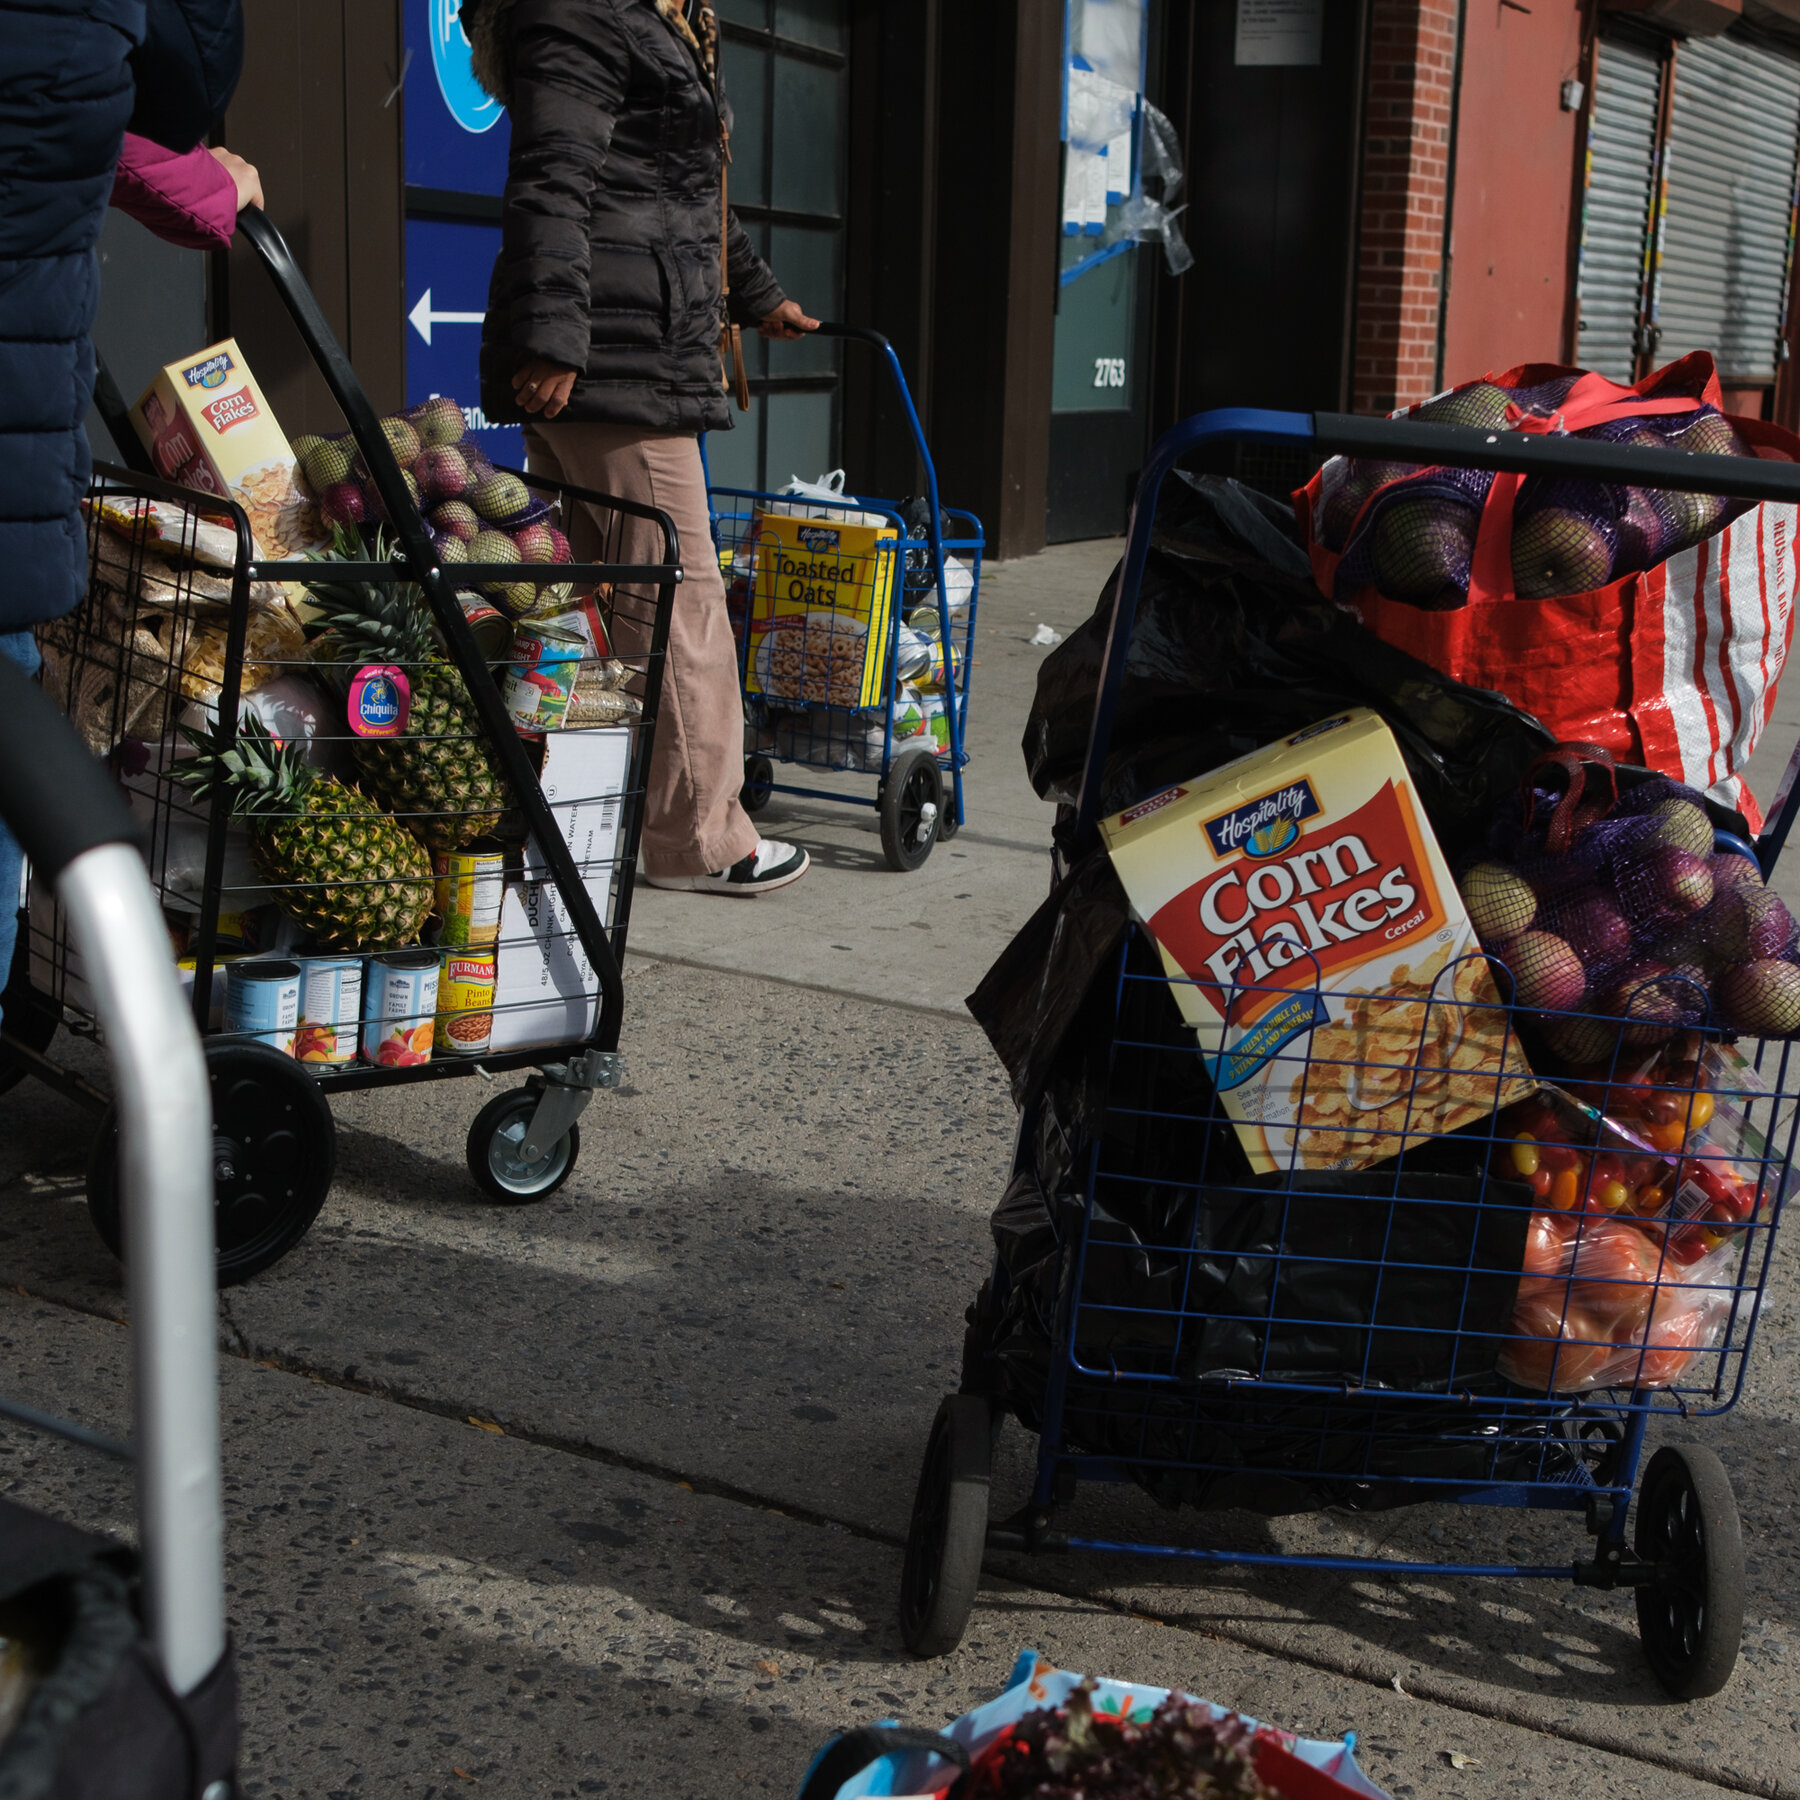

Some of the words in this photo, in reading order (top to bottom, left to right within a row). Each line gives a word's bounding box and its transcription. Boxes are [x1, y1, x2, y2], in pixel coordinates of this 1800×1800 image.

[188, 354, 228, 384] Hospitality
[1094, 358, 1125, 387] 2763
[210, 394, 245, 416] Corn
[212, 402, 254, 431] Flakes
[773, 553, 854, 583] Toasted
[1774, 520, 1786, 588] REUSABLE
[788, 580, 836, 605] Oats
[1778, 591, 1787, 620] BAG
[360, 704, 398, 718] Chiquita
[568, 804, 578, 838] WATER
[1218, 788, 1306, 848] Hospitality
[548, 884, 558, 912] LIGHT
[1200, 835, 1378, 936] Corn
[545, 916, 554, 950] CHUNK
[1204, 866, 1415, 1007] Flakes
[1384, 910, 1425, 940] Cereal
[544, 952, 551, 966] OZ
[541, 968, 549, 986] 48/5
[465, 998, 490, 1007] Beans
[467, 989, 490, 998] Pinto
[1264, 1008, 1290, 1034] SOURCE
[1290, 1001, 1302, 1014] OF
[1229, 1070, 1235, 1080] 9
[1266, 1032, 1280, 1049] AND
[1237, 1089, 1250, 1100] See
[1252, 1083, 1267, 1093] side
[1241, 1094, 1262, 1111] panel
